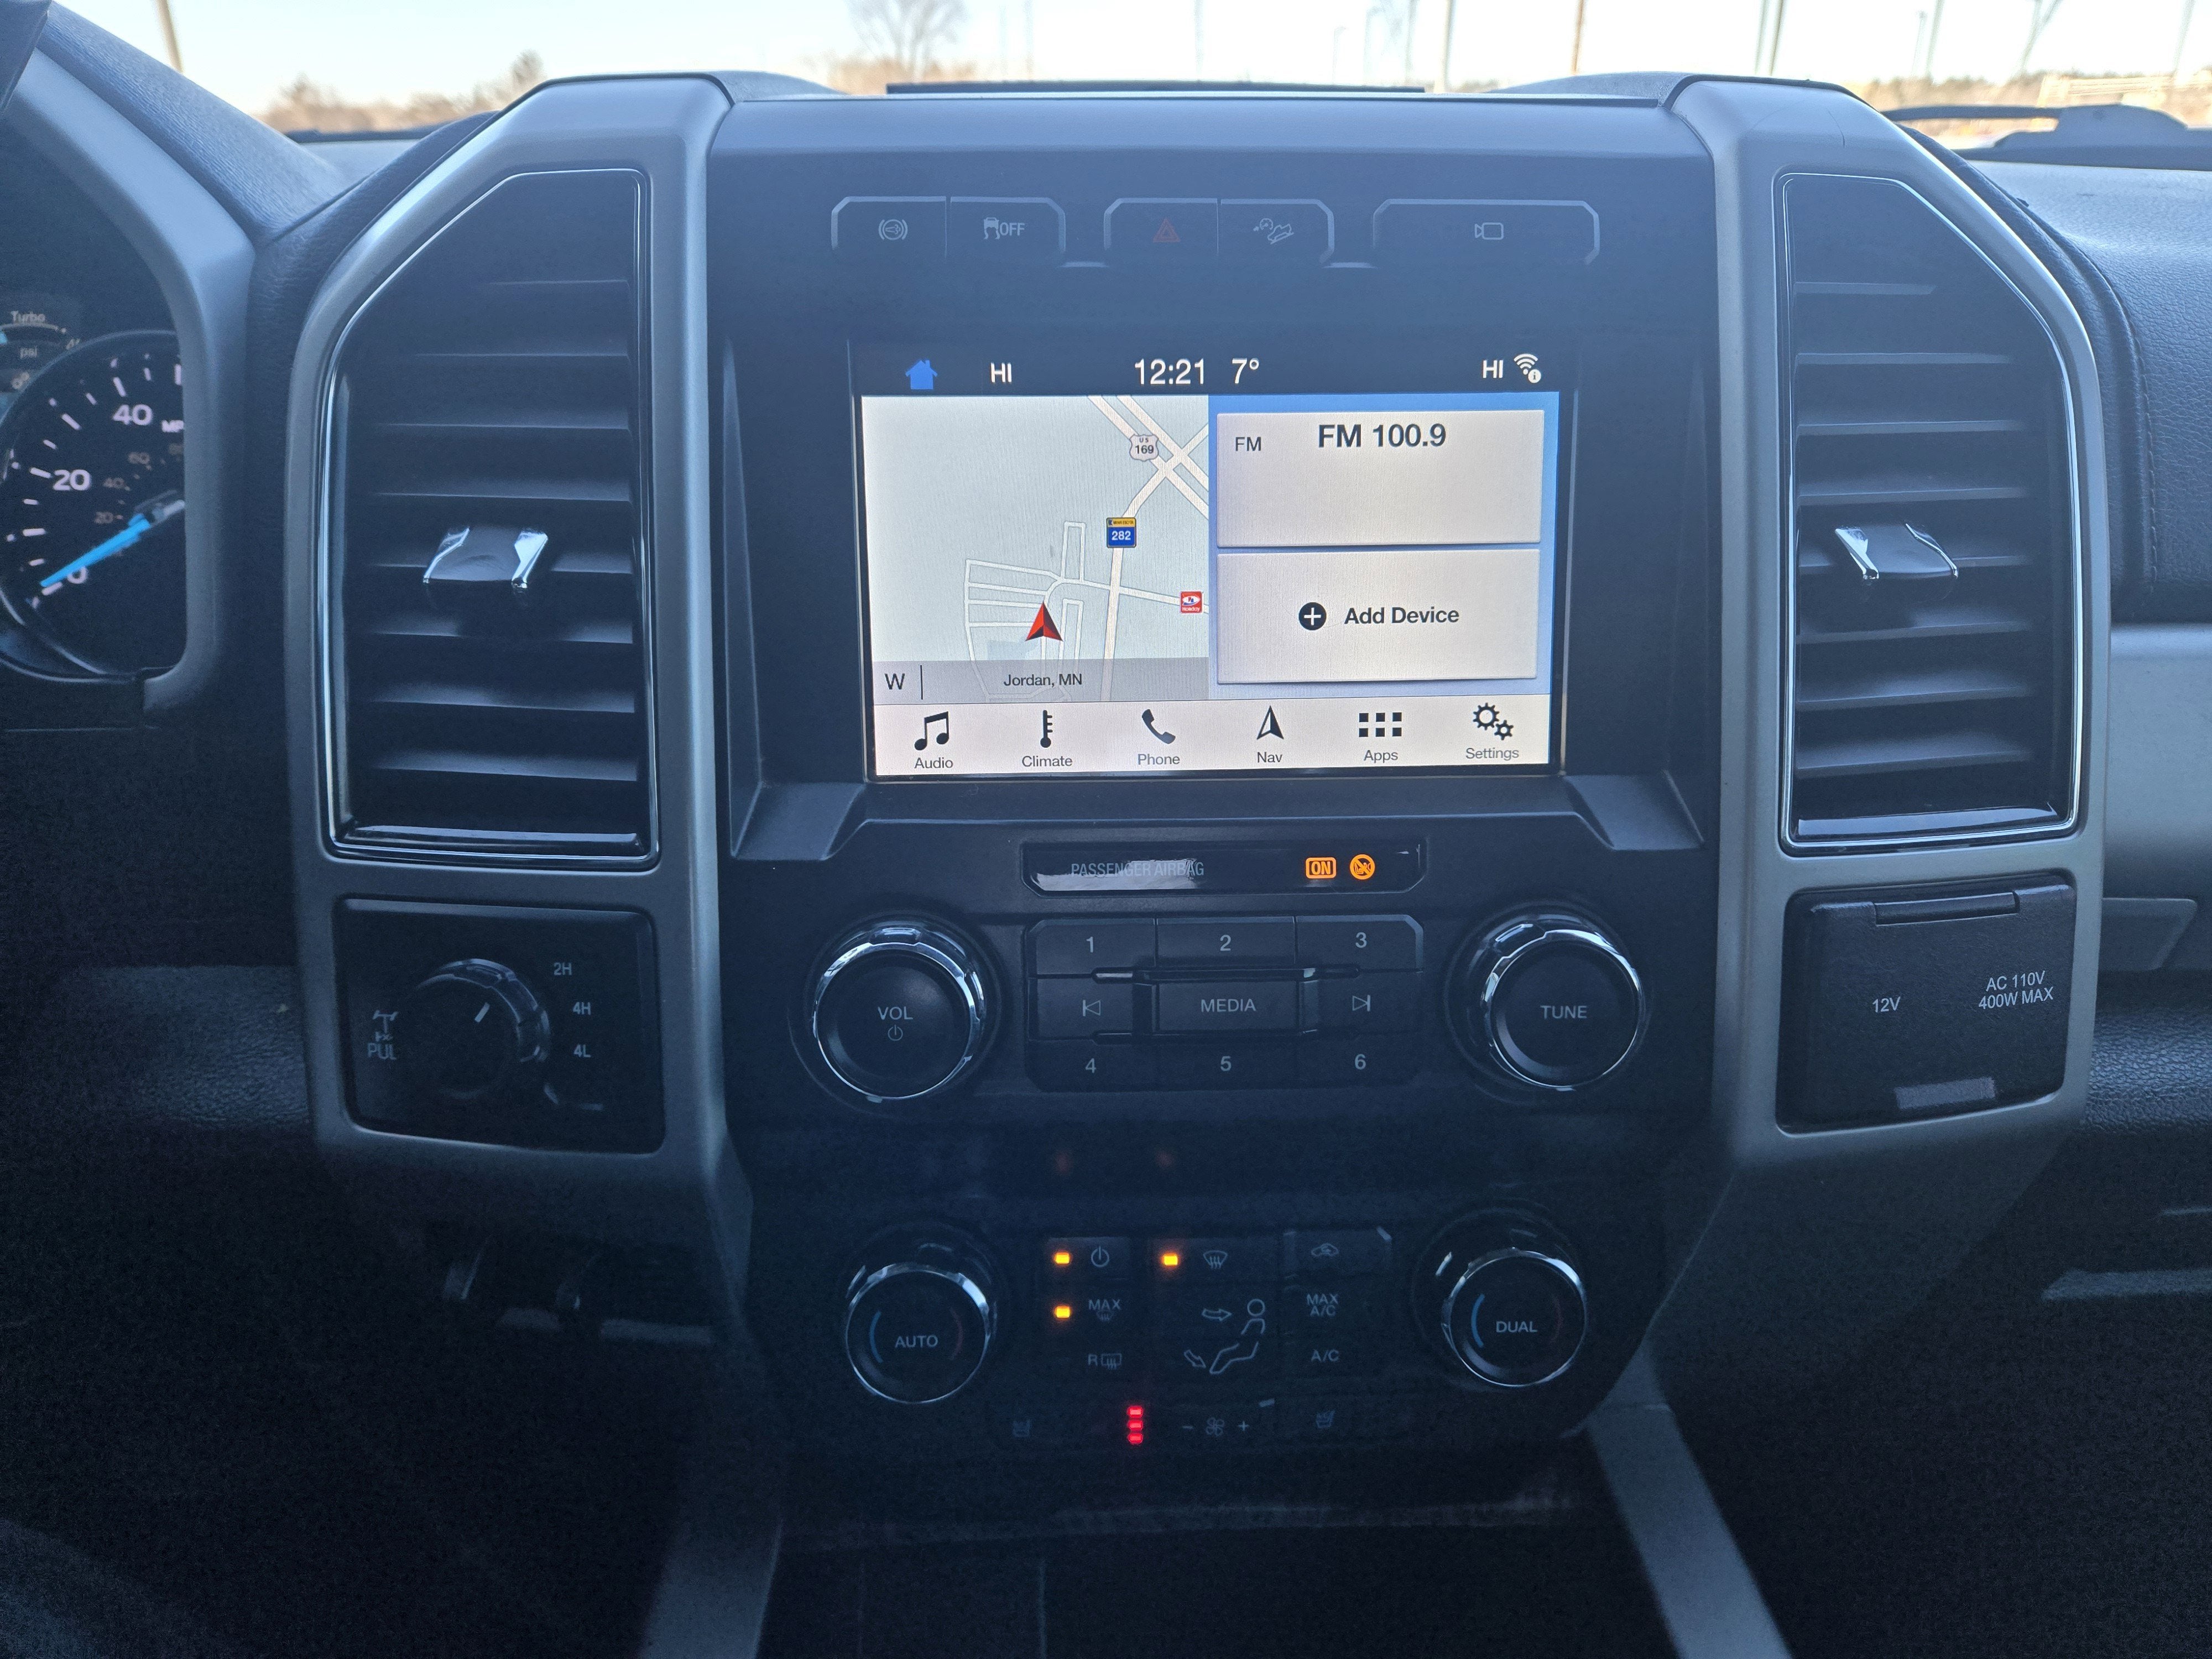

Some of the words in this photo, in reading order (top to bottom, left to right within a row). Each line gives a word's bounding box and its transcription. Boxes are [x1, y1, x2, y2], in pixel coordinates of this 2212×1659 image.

[999, 222, 1026, 236] OFF
[11, 310, 46, 322] Turbo
[990, 363, 1012, 383] HI
[1134, 358, 1205, 385] 12:21
[1232, 358, 1260, 384] 7°
[1482, 360, 1504, 379] HI
[112, 404, 153, 426] 40
[1318, 424, 1362, 448] FM
[1373, 423, 1447, 447] 100.9
[1135, 445, 1154, 455] 169
[1235, 436, 1262, 452] FM
[53, 469, 92, 491] 20
[1111, 530, 1131, 541] 282
[1344, 607, 1385, 625] Add
[1391, 606, 1460, 624] Device
[885, 673, 905, 690] W
[1004, 674, 1055, 688] Jordan,
[1058, 673, 1082, 686] MN
[1138, 754, 1180, 766] Phone
[1257, 752, 1283, 763] Nav
[1364, 749, 1399, 764] Apps
[1465, 747, 1520, 761] Settings
[914, 757, 953, 769] Audio
[1022, 756, 1073, 768] Climate
[1071, 863, 1151, 877] PASSENGER
[1154, 862, 1204, 876] AIRBAG
[1311, 860, 1331, 875] ON
[1086, 937, 1094, 953] 1
[1219, 935, 1232, 952] 2
[1355, 932, 1367, 949] 3
[554, 962, 572, 975] 2H
[1986, 975, 2007, 992] AC
[2011, 970, 2045, 988] 110V
[1872, 997, 1901, 1013] 12V
[1979, 992, 2018, 1010] 400W
[2021, 987, 2054, 1005] MAX
[573, 1001, 591, 1015] 4H
[878, 1006, 913, 1020] VOL
[1201, 999, 1256, 1013] MEDIA
[1540, 1005, 1587, 1019] TUNE
[573, 1044, 591, 1057] 4L
[1085, 1058, 1097, 1074] 4
[1220, 1056, 1232, 1072] 5
[1354, 1055, 1366, 1071] 6
[1088, 1299, 1121, 1311] MAX
[1306, 1293, 1339, 1305] MAX
[1310, 1303, 1336, 1317] A/C
[1495, 1321, 1538, 1333] DUAL
[895, 1334, 938, 1348] AUTO
[1088, 1354, 1098, 1366] R
[1311, 1349, 1339, 1362] A/C
